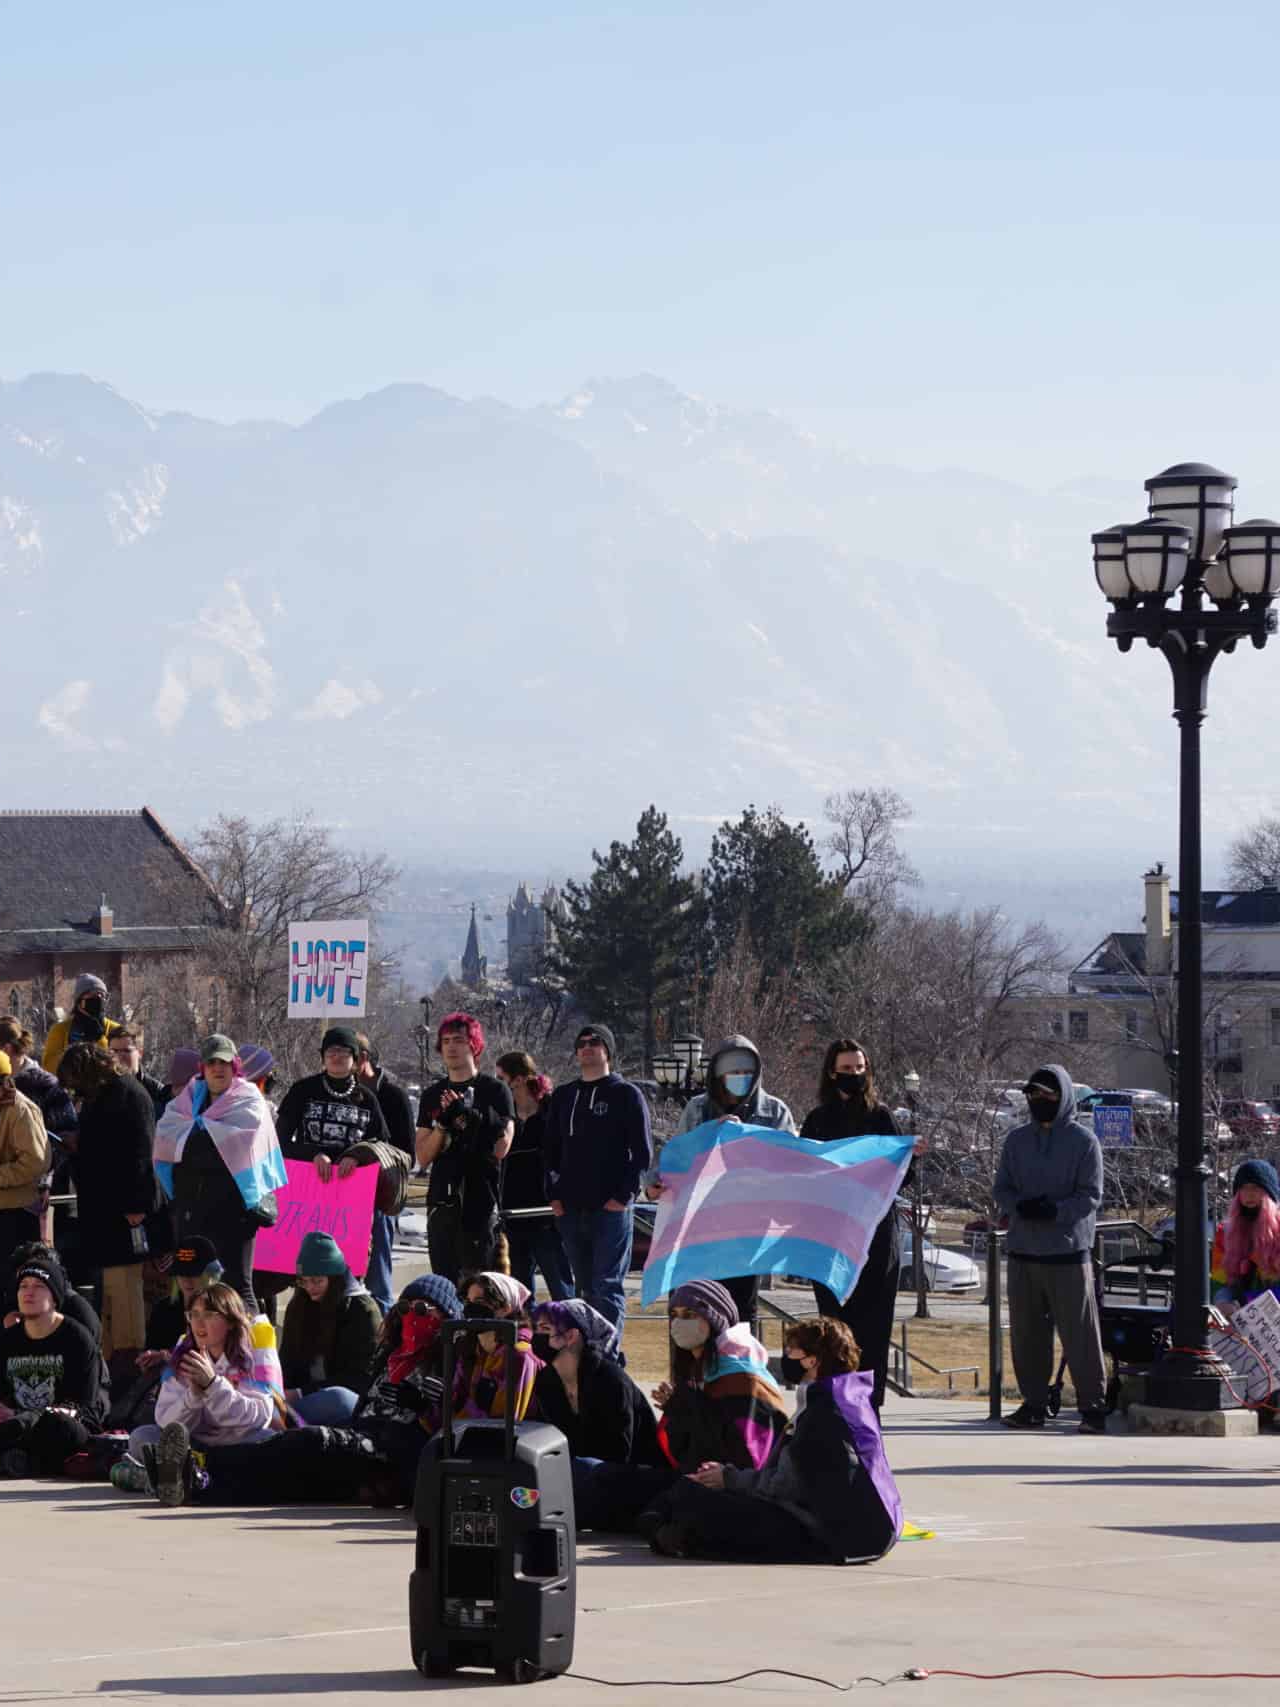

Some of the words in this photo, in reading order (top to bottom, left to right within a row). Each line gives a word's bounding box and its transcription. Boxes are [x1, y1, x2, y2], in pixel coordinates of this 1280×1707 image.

[291, 939, 366, 1007] HOPE
[1095, 1110, 1130, 1121] VISITOR
[273, 1201, 353, 1241] TRANS
